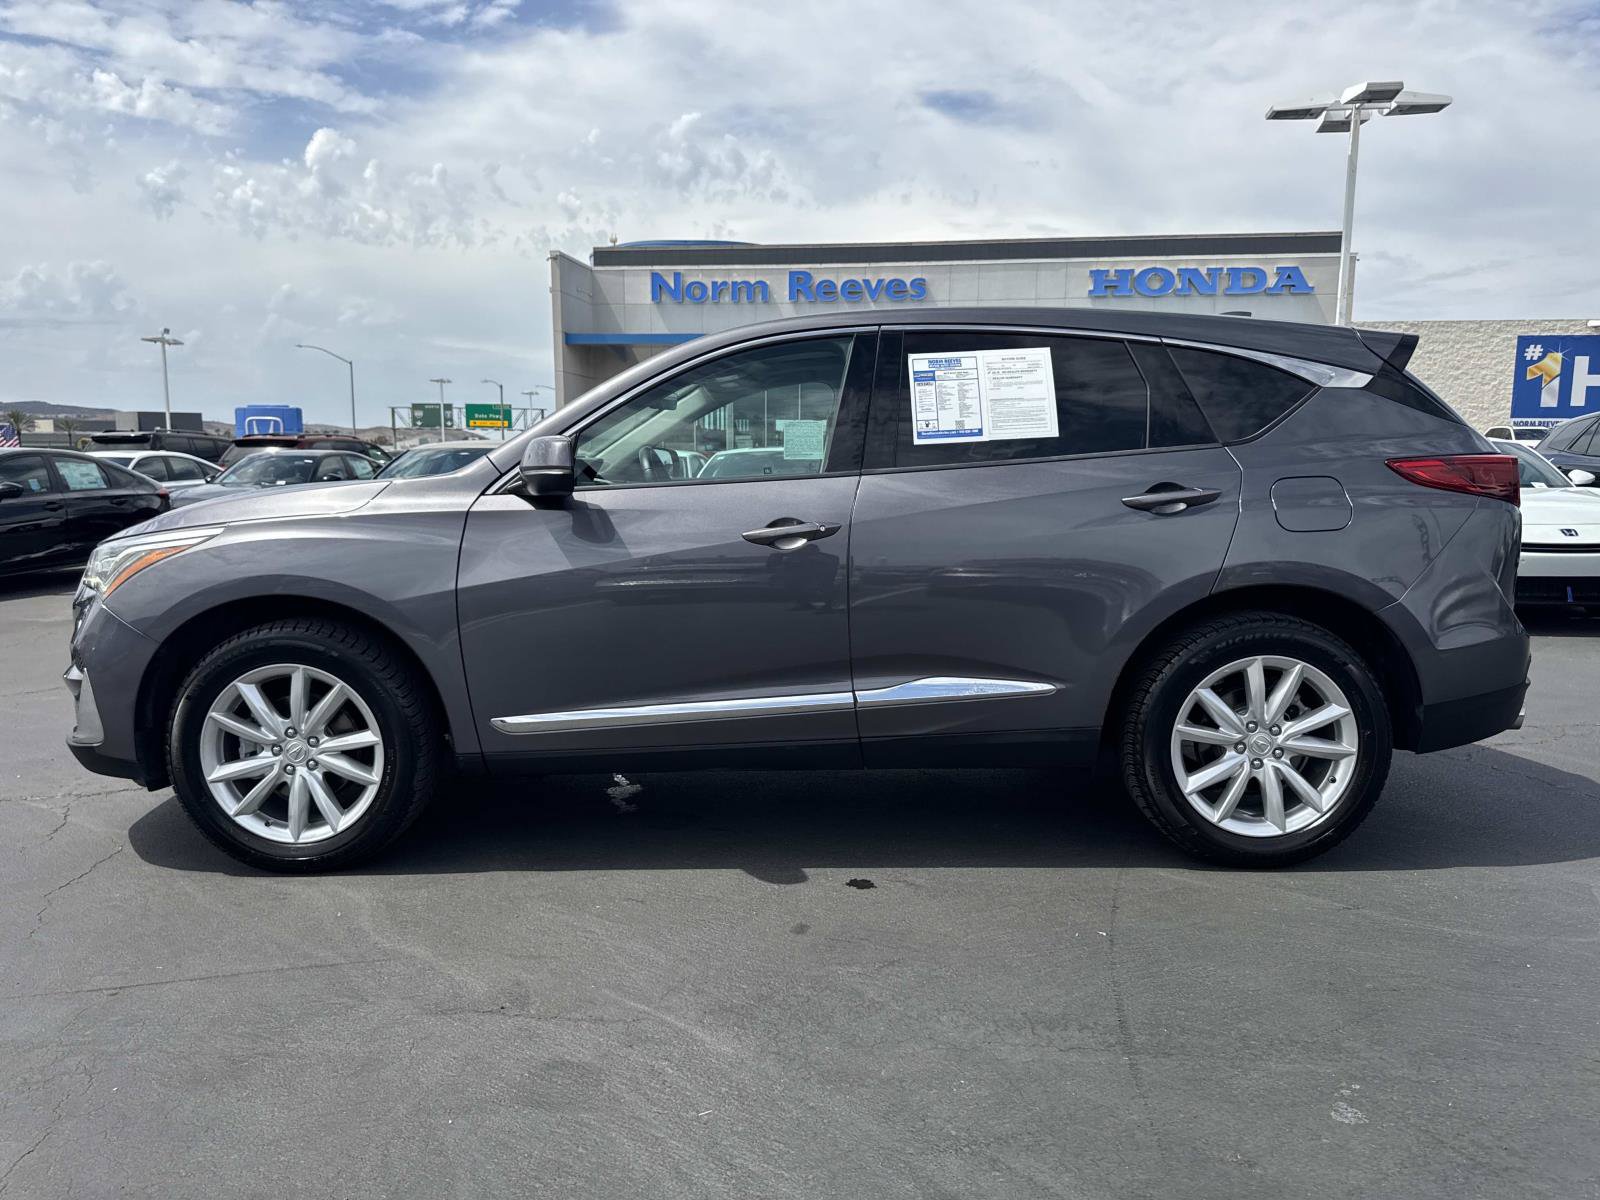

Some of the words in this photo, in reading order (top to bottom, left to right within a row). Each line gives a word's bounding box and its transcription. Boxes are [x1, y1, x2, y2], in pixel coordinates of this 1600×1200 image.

[651, 271, 769, 304] Norm
[788, 270, 928, 303] Reeves
[1088, 266, 1315, 297] HONDA
[1215, 632, 1291, 649] MICHELIN
